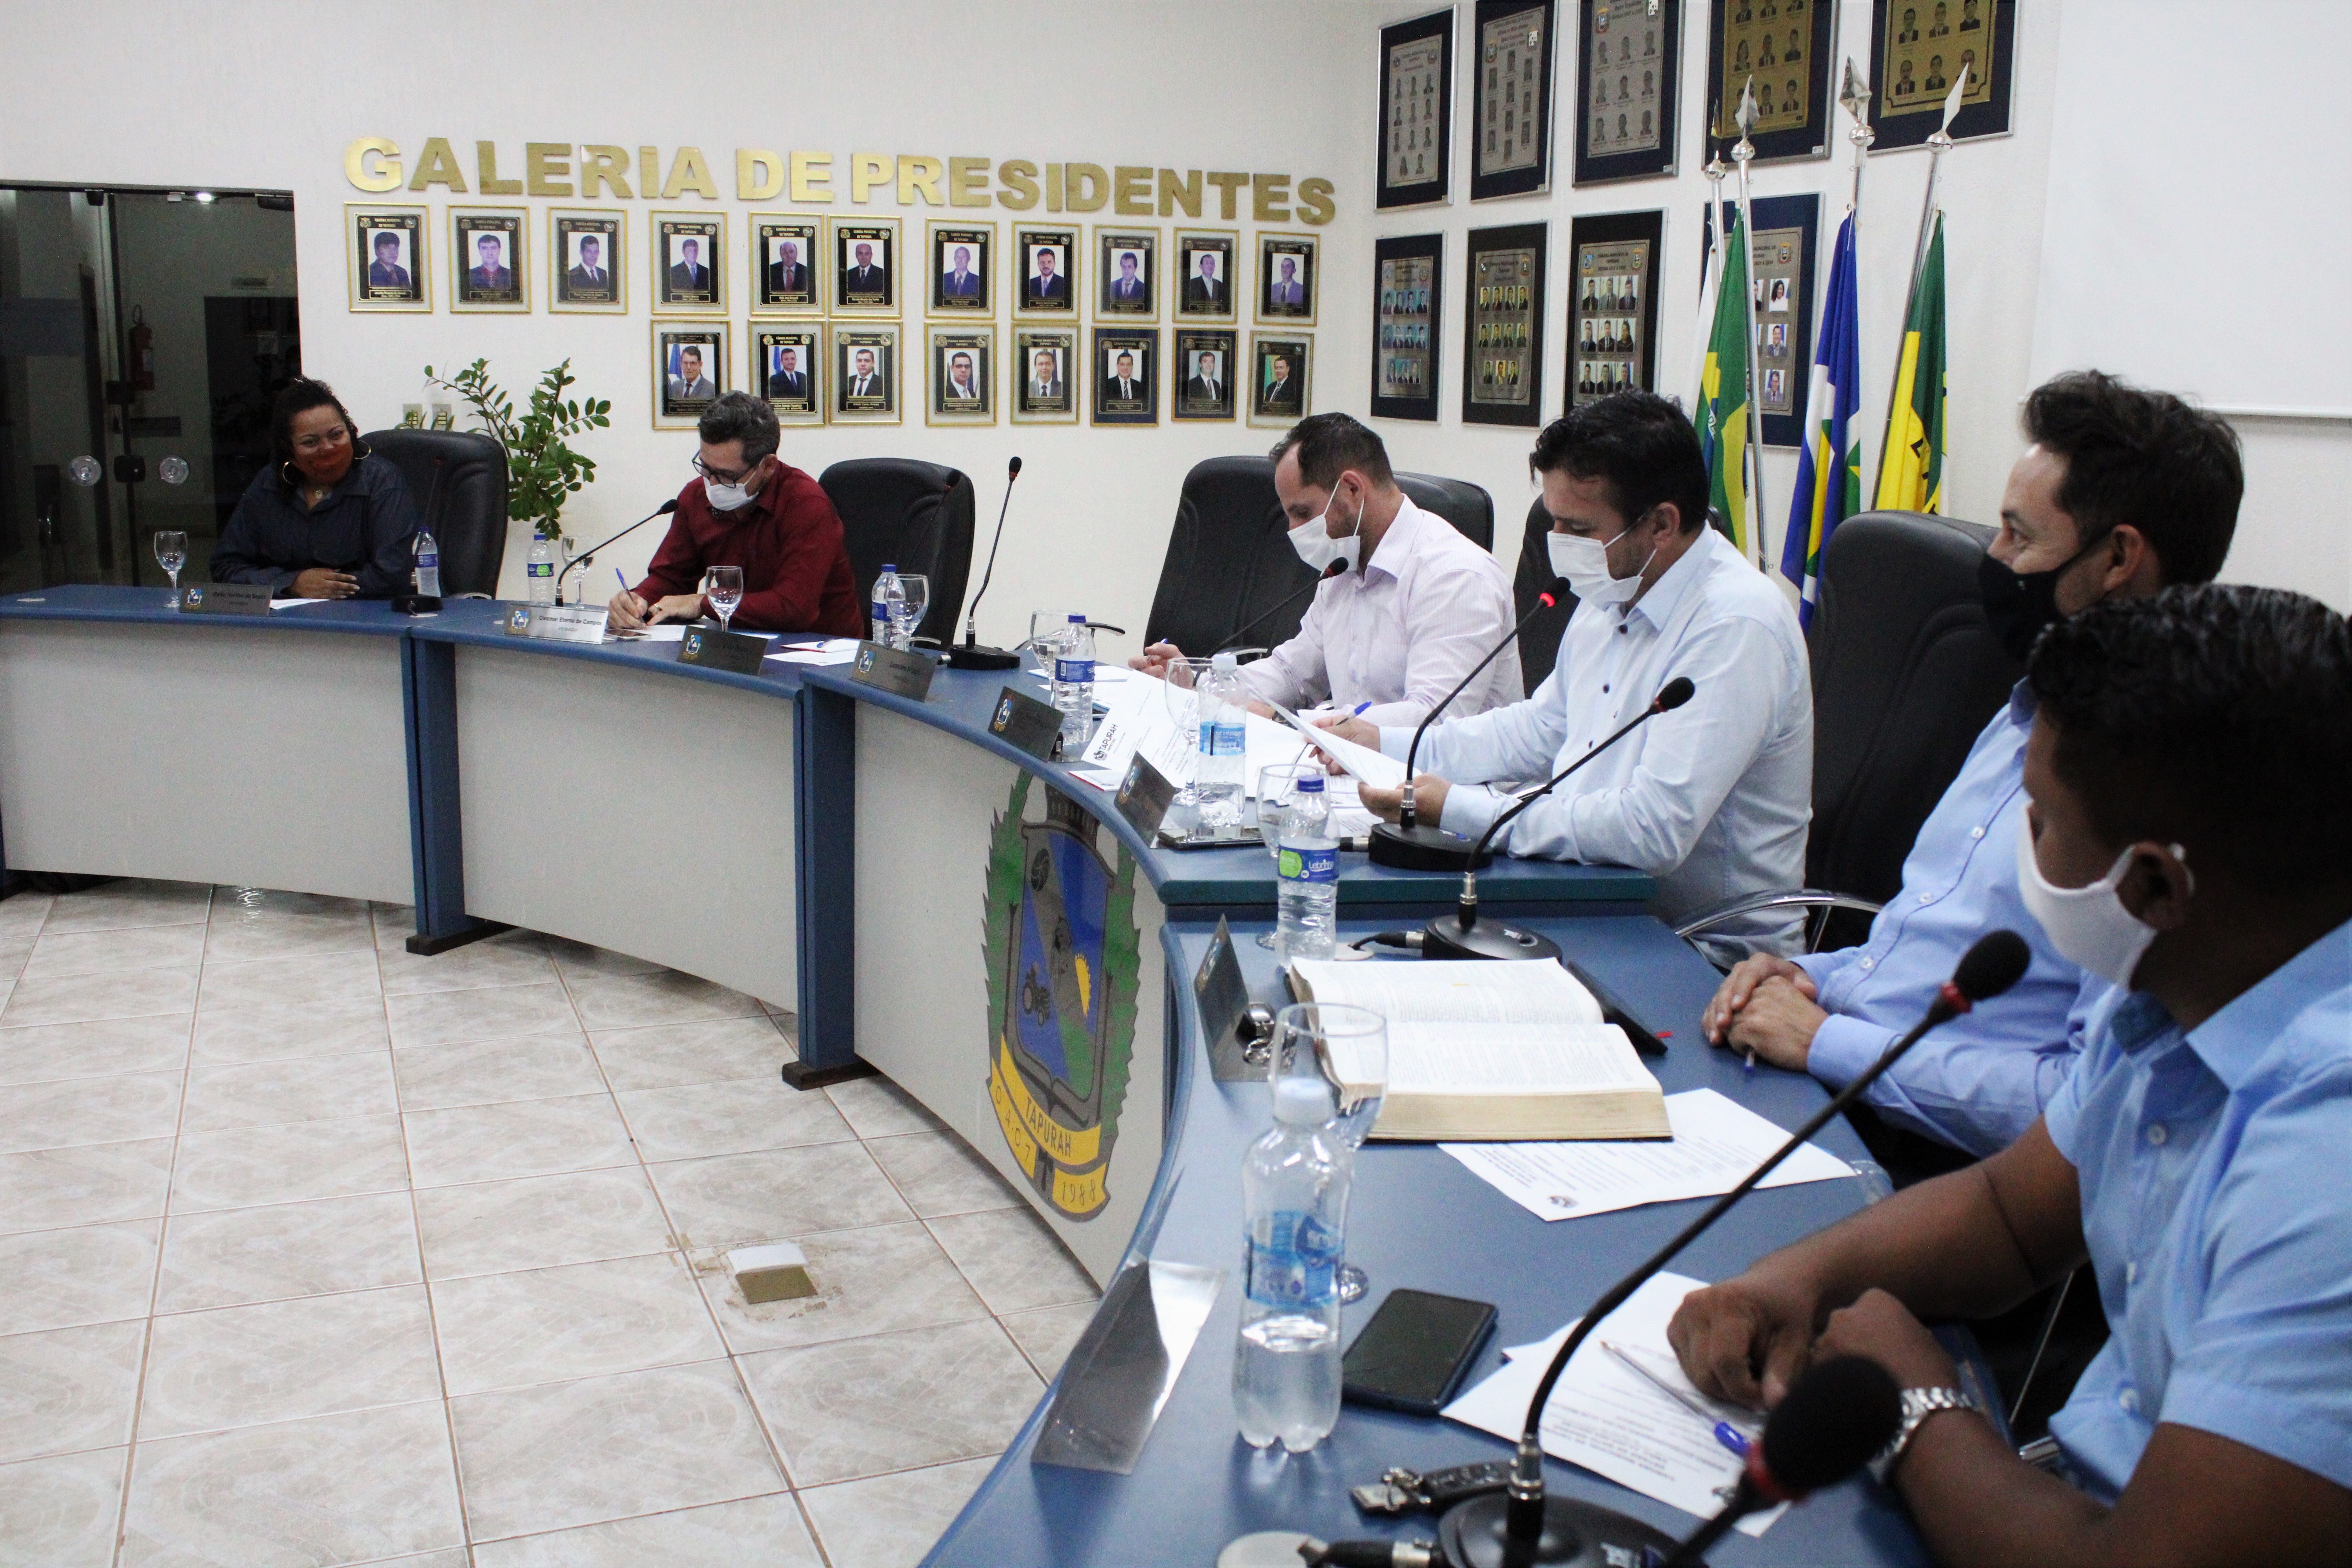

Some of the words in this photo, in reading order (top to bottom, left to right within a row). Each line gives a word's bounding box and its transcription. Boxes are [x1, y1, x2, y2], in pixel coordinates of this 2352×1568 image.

[344, 136, 718, 199] GALERIA
[737, 149, 834, 202] DE
[851, 152, 1336, 225] PRESIDENTES
[1099, 724, 1118, 750] TAPURAH
[1026, 1096, 1071, 1157] TAPURAH
[1062, 1179, 1096, 1206] 1988
